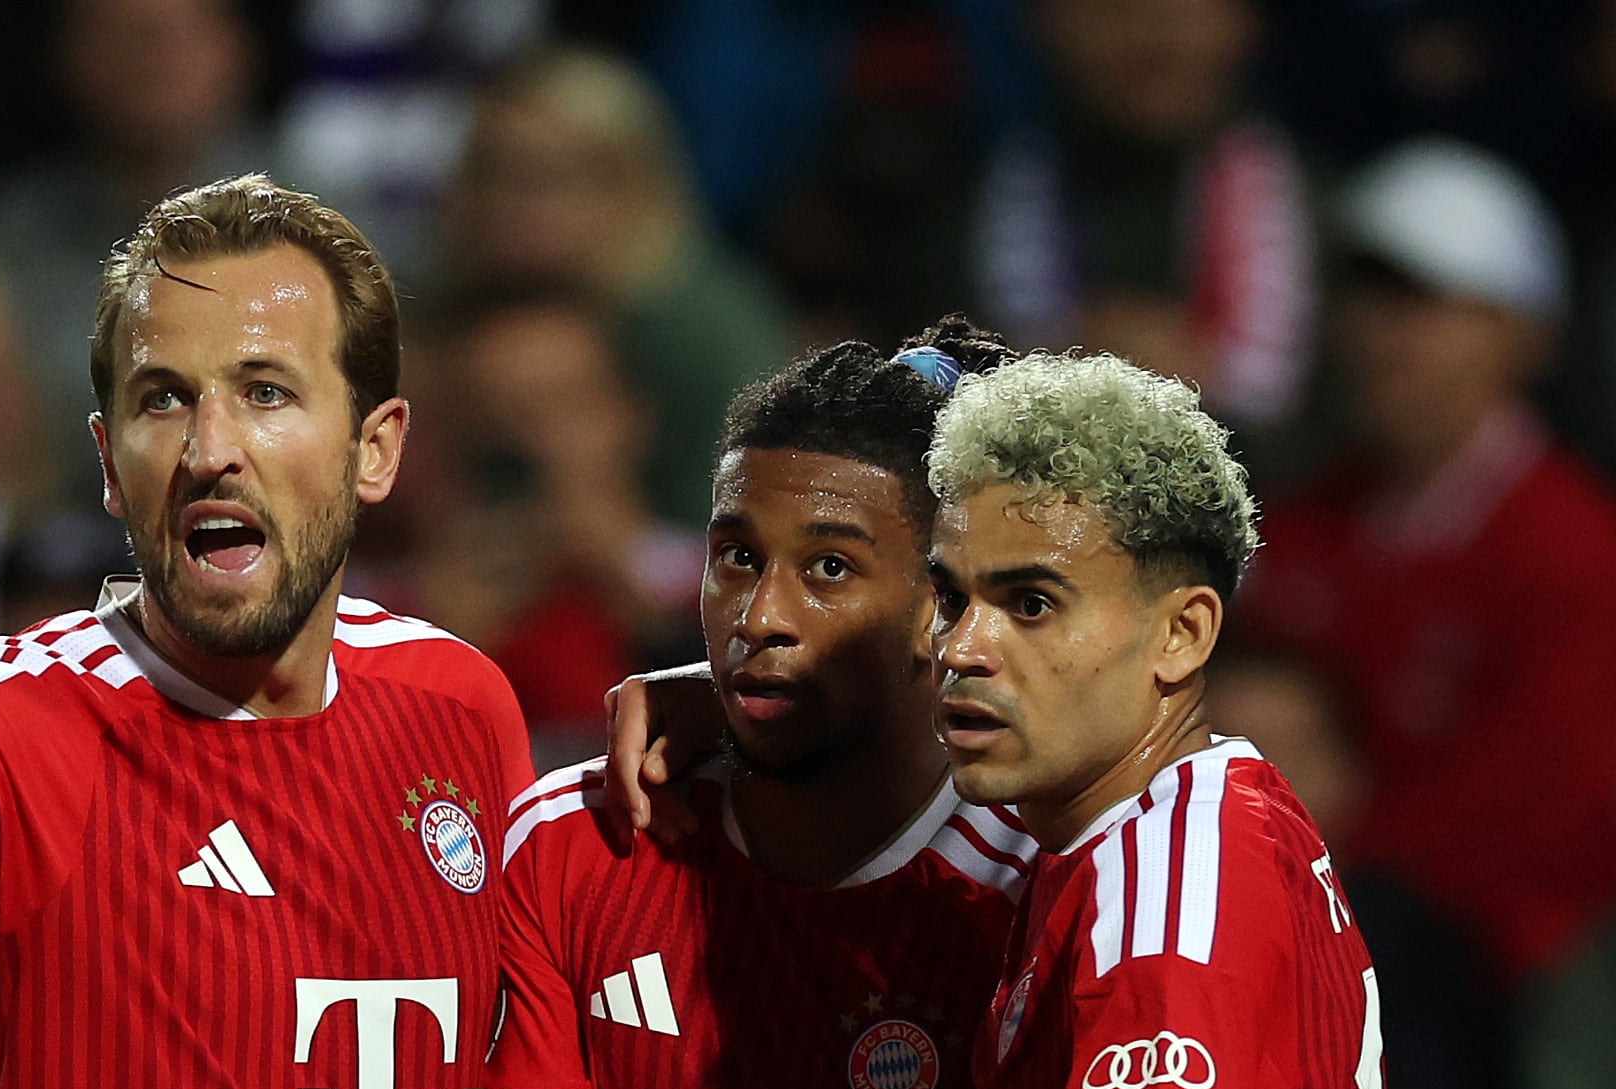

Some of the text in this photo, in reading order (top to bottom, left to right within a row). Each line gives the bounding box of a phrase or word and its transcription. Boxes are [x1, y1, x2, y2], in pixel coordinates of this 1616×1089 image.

[426, 807, 474, 844] FC BAYERN
[879, 1025, 934, 1063] BAYERN
